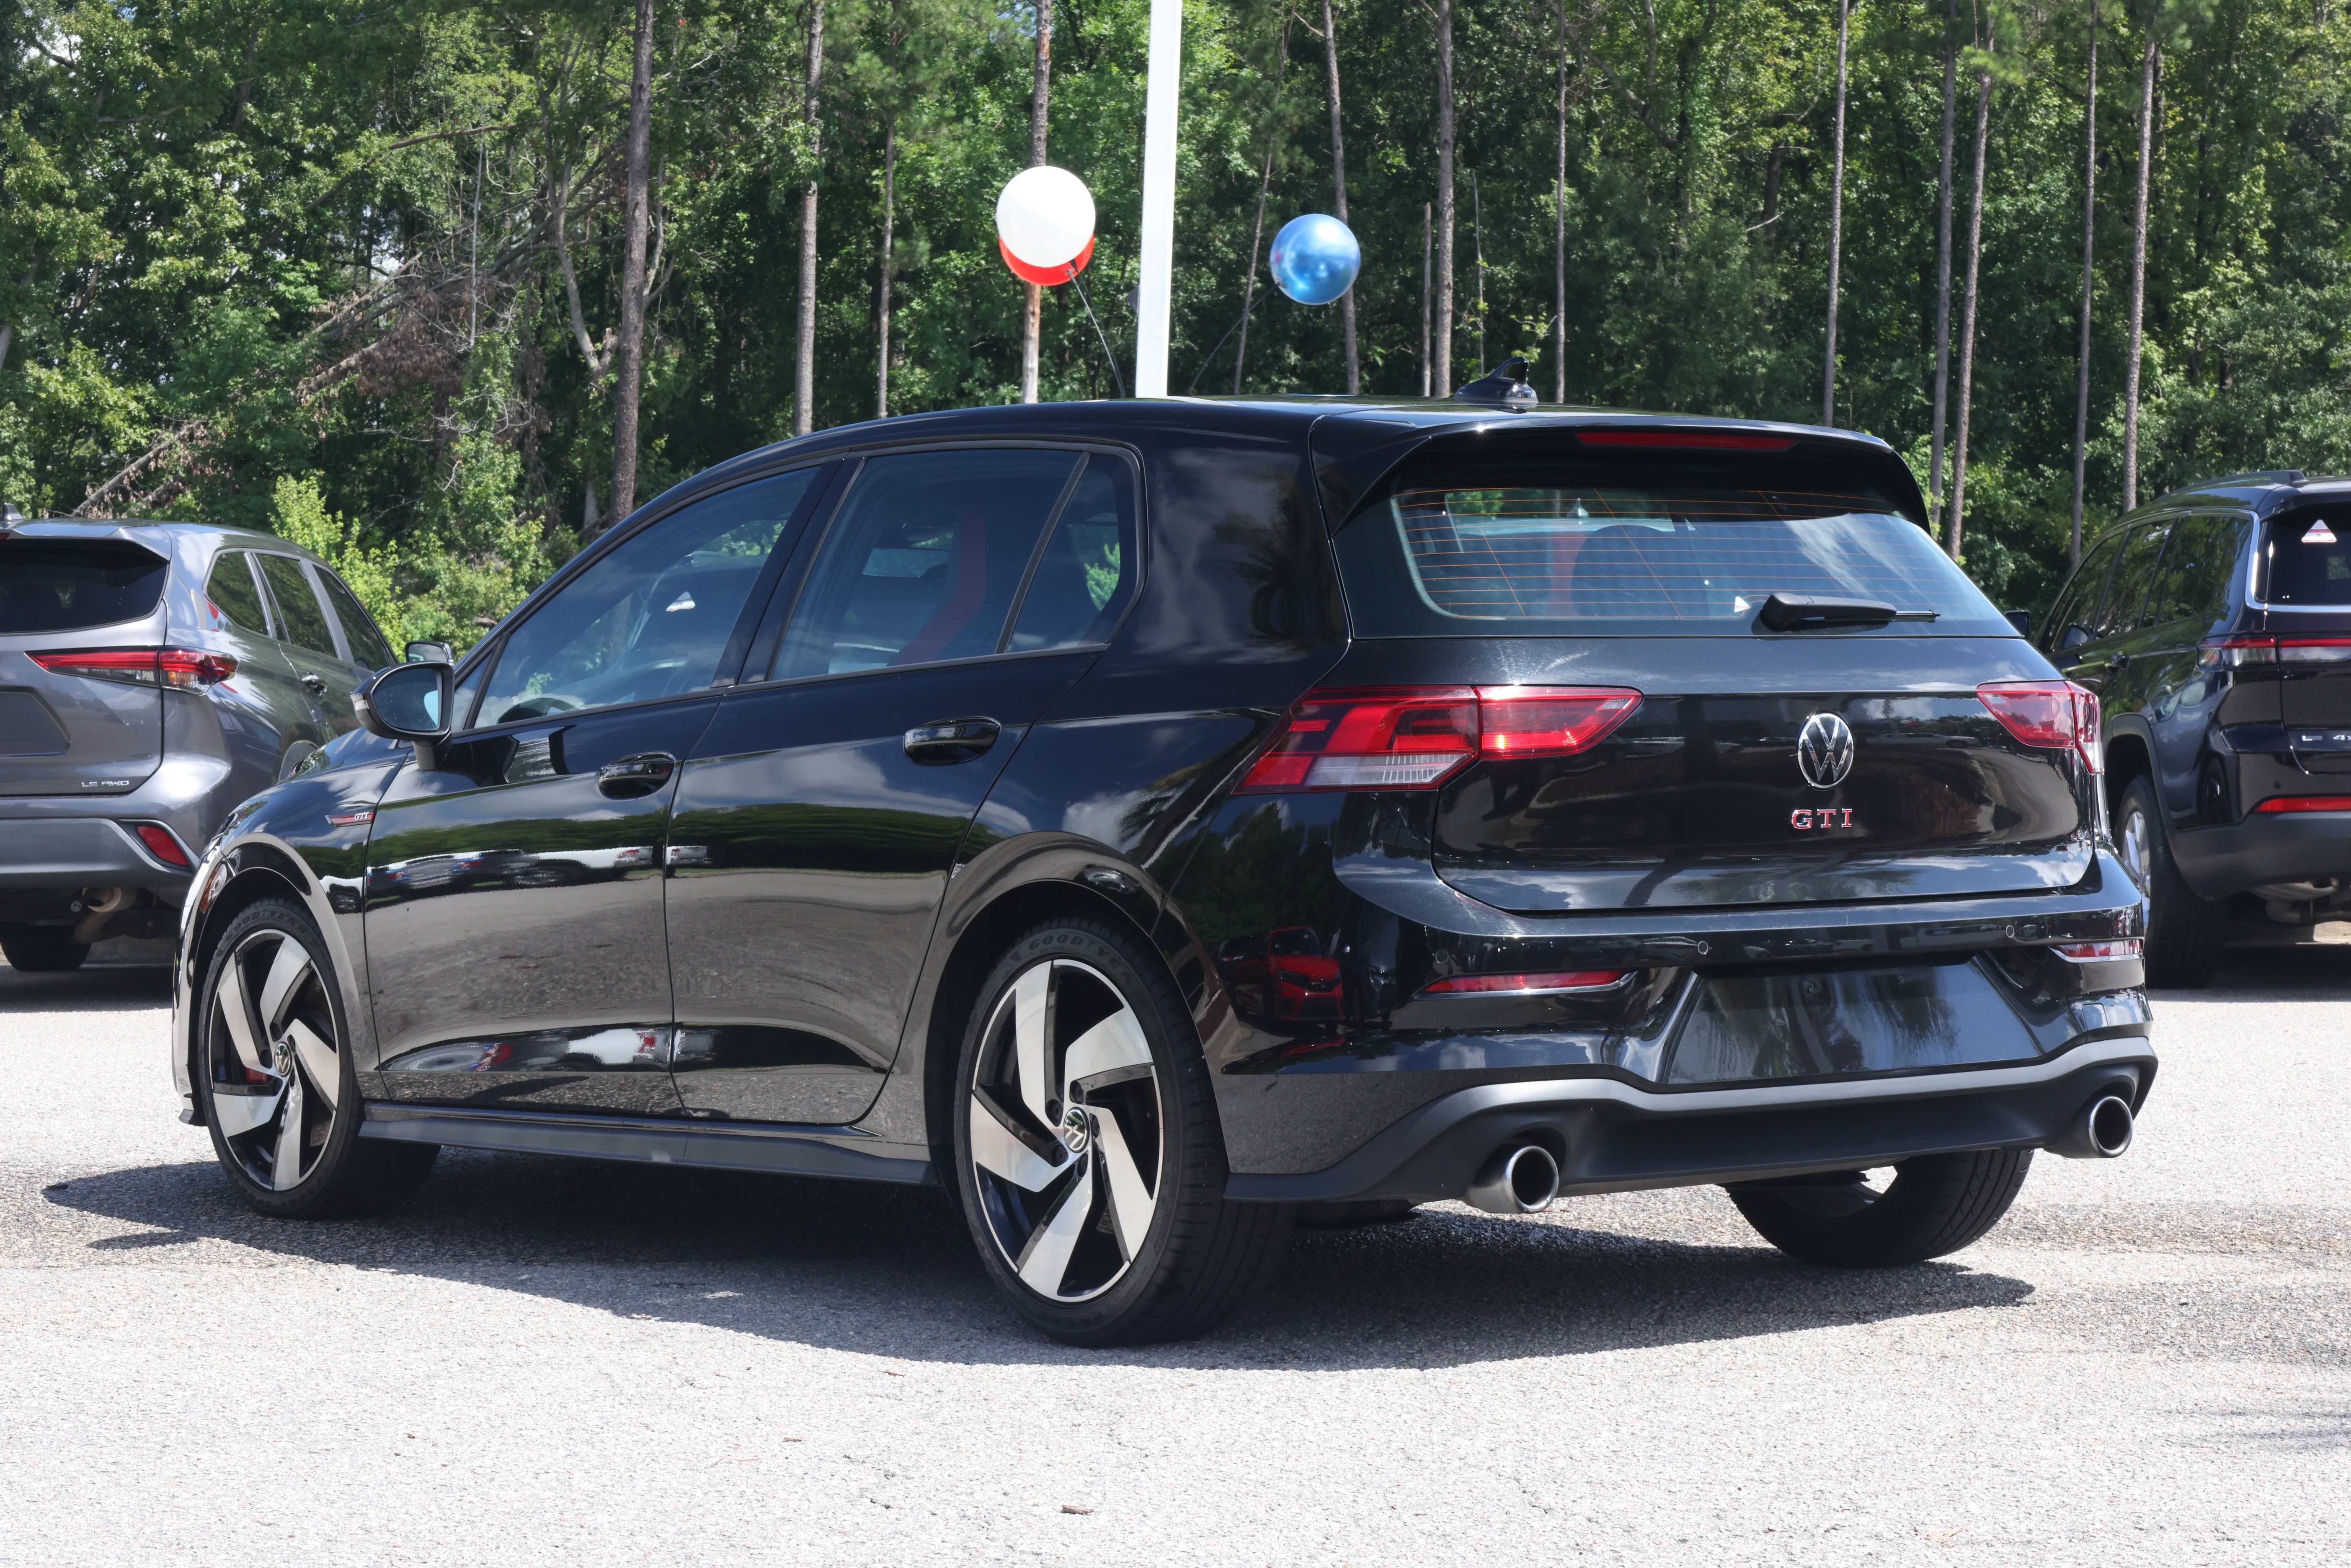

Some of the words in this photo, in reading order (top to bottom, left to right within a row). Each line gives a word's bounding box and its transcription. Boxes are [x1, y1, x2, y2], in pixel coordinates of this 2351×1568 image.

[1798, 713, 1854, 788] VW
[353, 811, 369, 821] GTI
[1791, 808, 1853, 829] GTI
[226, 910, 307, 942] GOODYEAR
